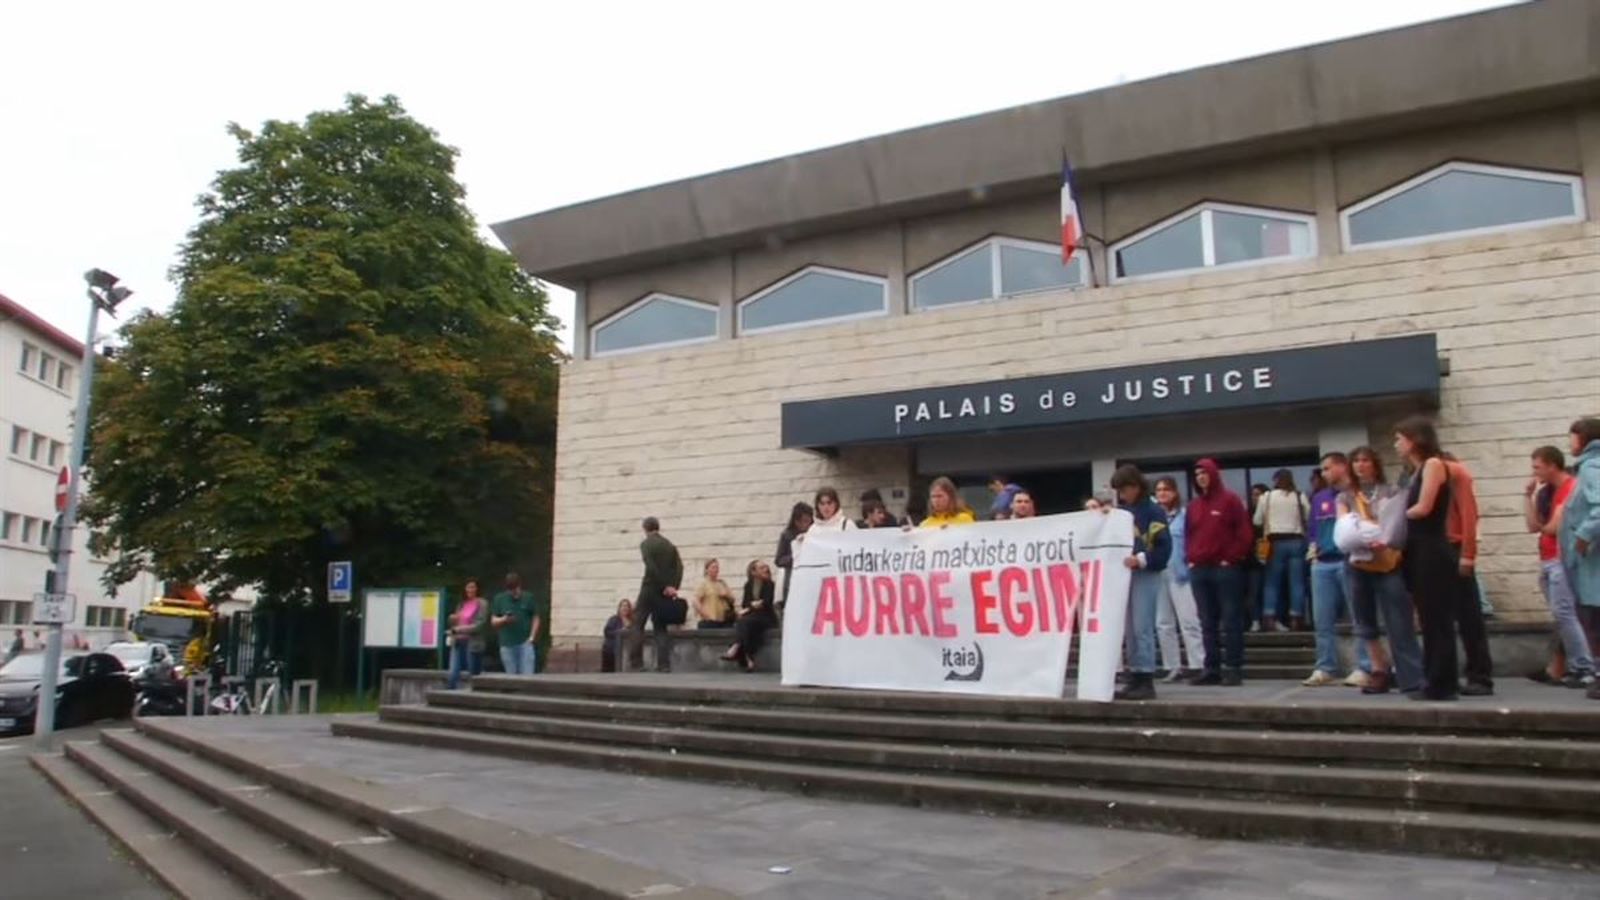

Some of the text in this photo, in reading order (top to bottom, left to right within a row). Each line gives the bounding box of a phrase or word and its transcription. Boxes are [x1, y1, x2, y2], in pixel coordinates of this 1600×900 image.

[894, 366, 1273, 423] PALAIS de JUSTICE
[837, 531, 1076, 574] indarkeria matxista orori
[333, 567, 344, 588] P
[810, 570, 959, 639] AURRE
[942, 646, 976, 668] itaia
